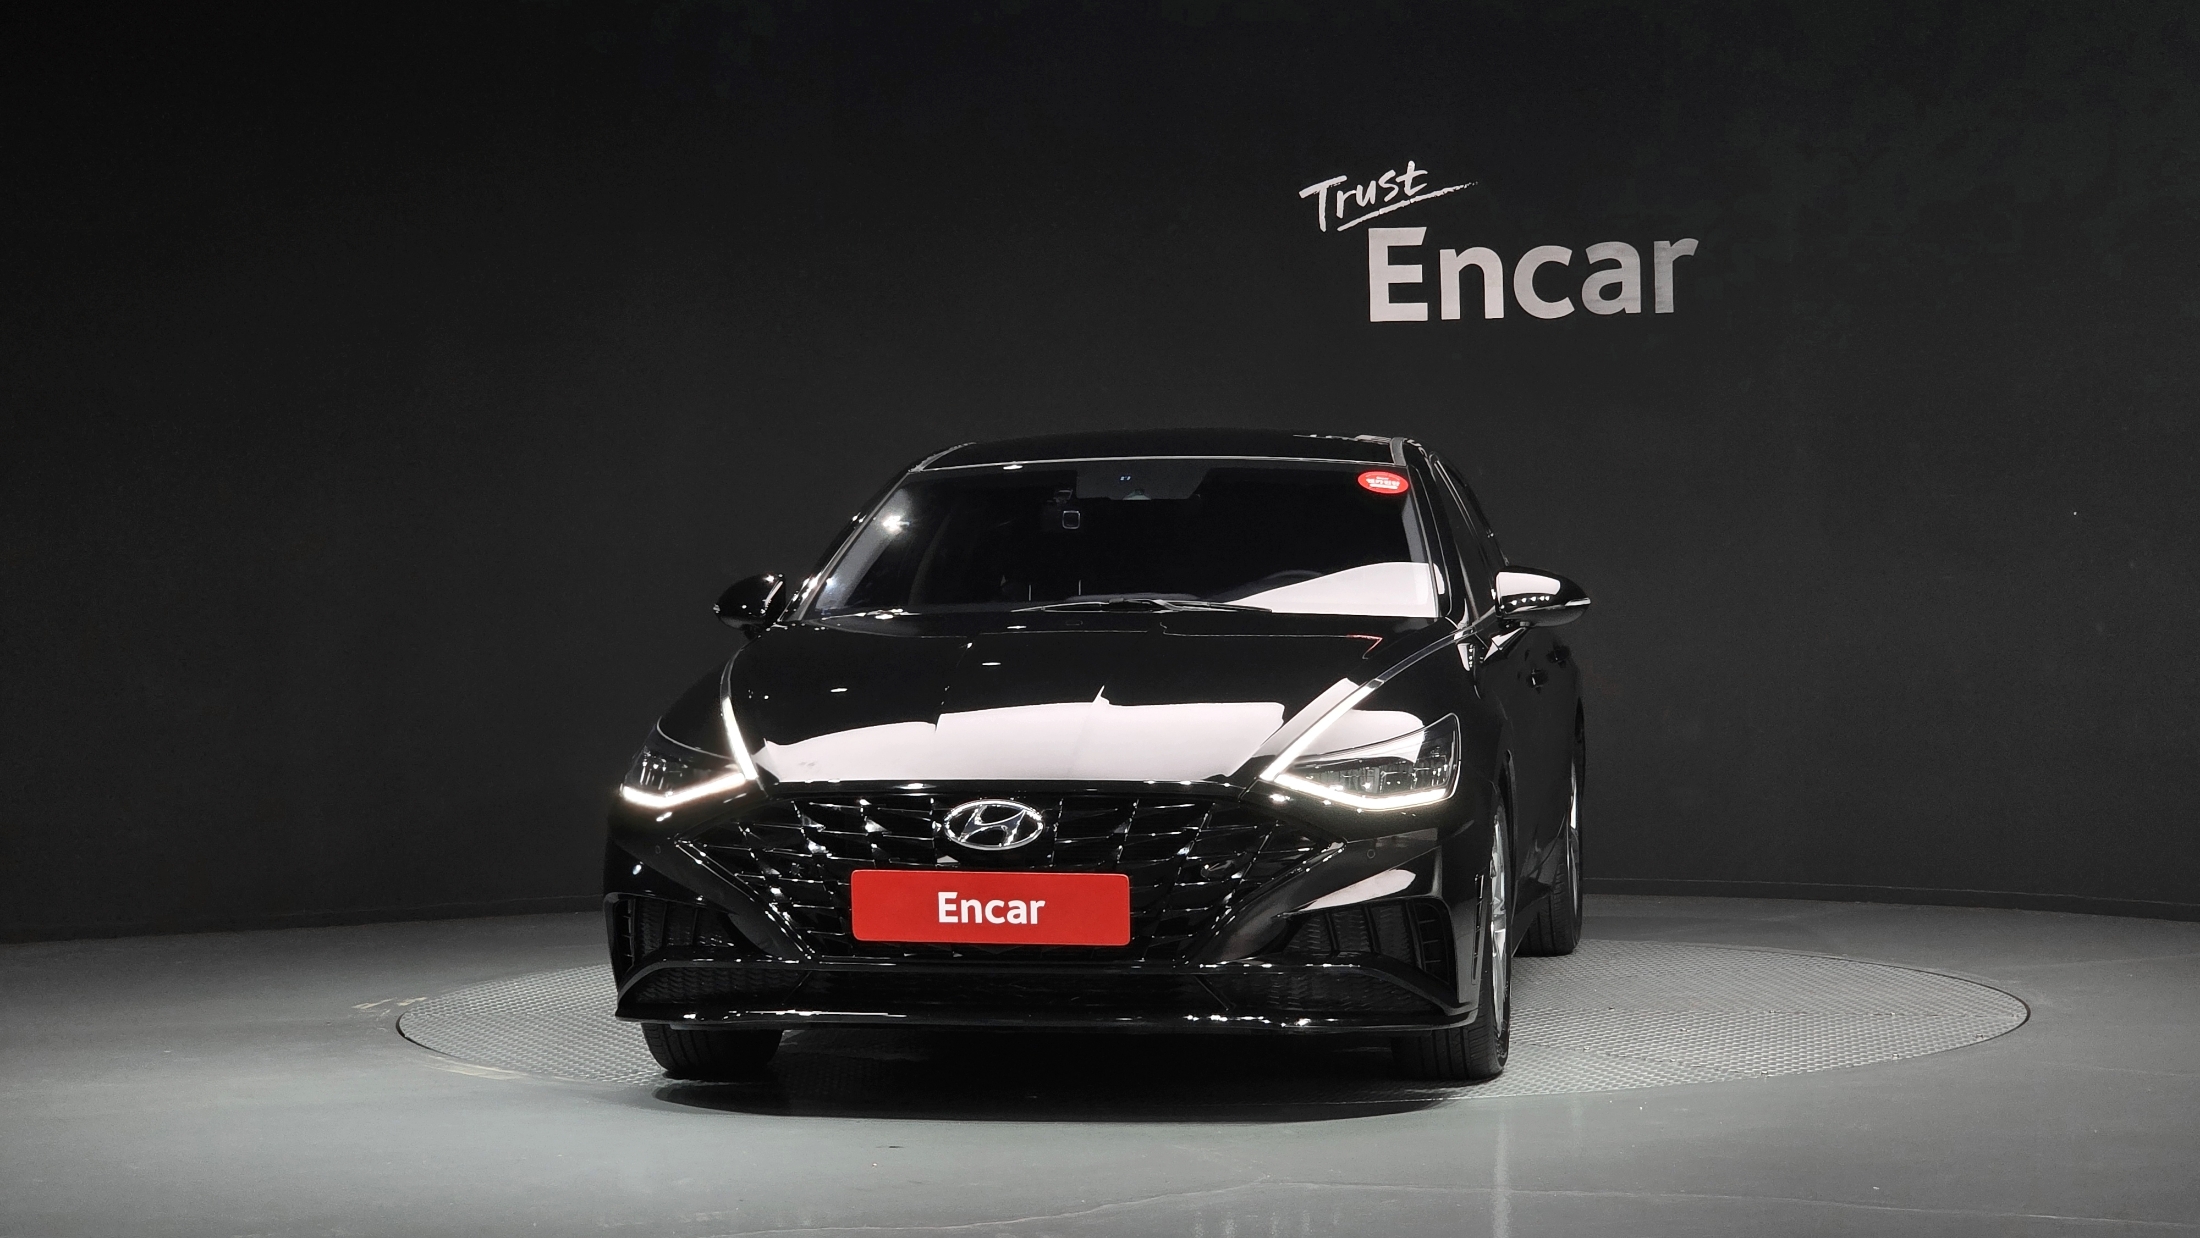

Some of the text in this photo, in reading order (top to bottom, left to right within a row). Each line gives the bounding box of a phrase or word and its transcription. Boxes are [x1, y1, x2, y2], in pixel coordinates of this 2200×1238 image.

[1298, 160, 1429, 233] Trust
[1367, 226, 1699, 323] Encar
[937, 891, 1046, 925] Encar
